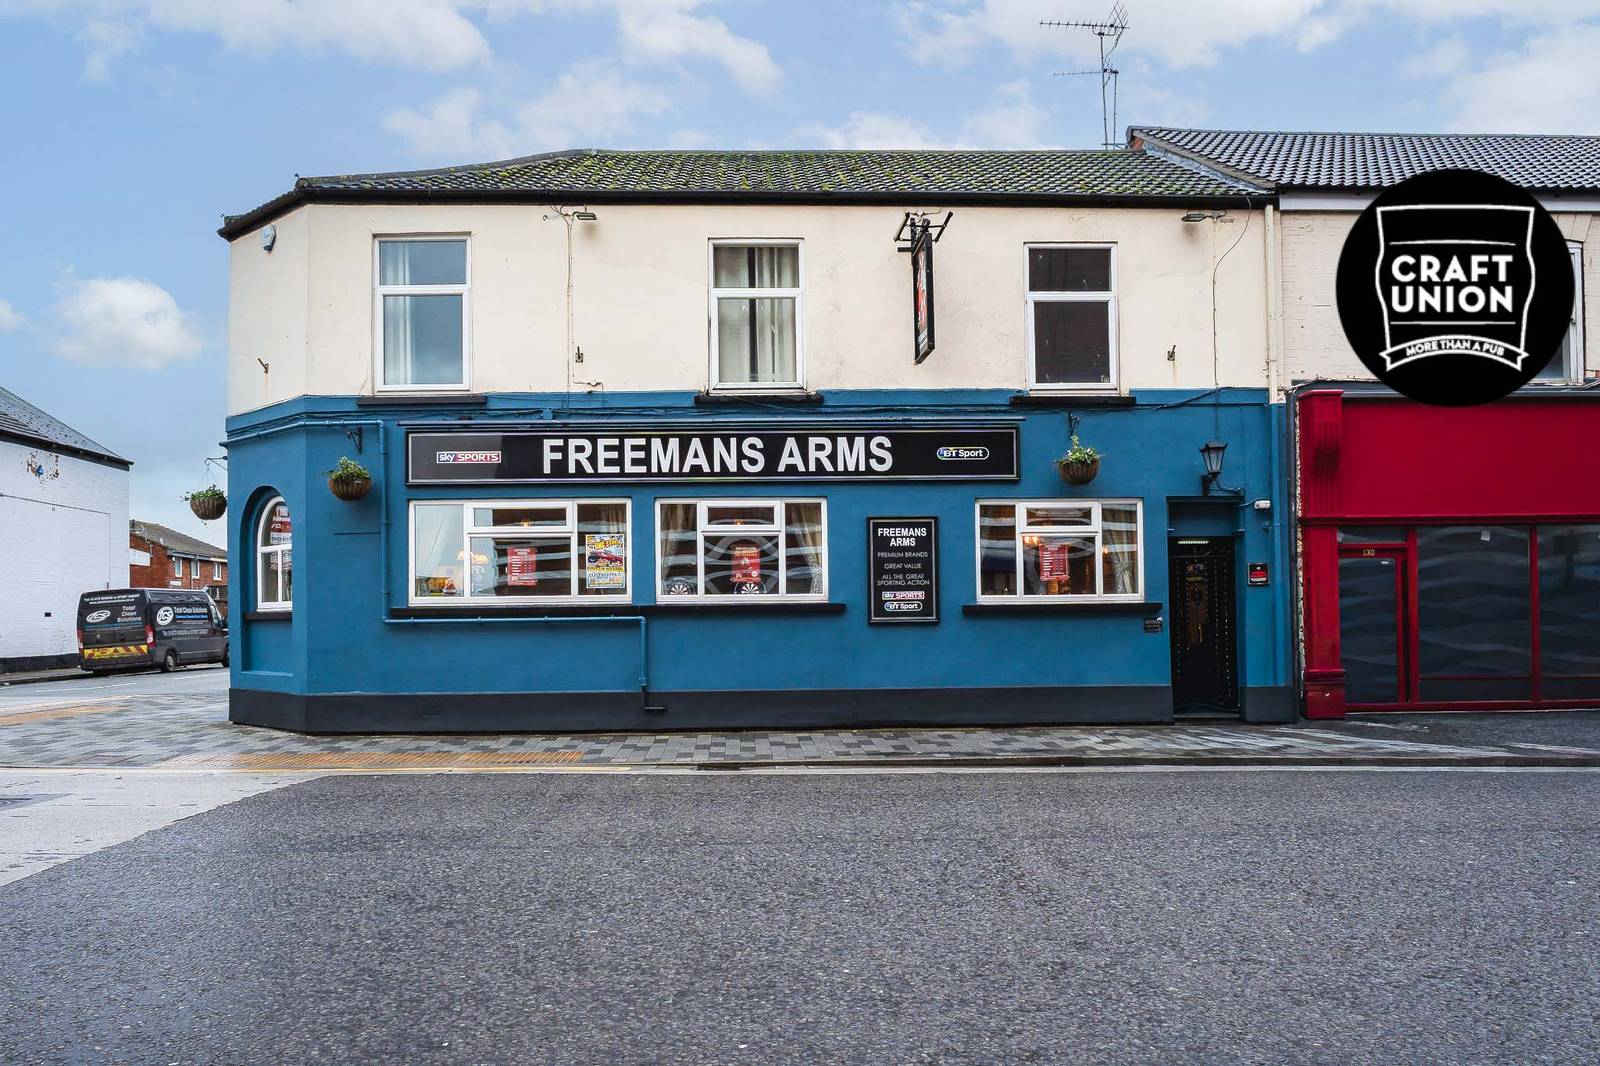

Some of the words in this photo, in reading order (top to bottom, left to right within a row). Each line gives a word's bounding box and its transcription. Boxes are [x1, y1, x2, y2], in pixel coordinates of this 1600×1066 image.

[439, 452, 455, 464] sky
[457, 453, 499, 462] SPORTS
[543, 437, 765, 474] FREEMANS
[777, 436, 893, 473] ARMS
[943, 448, 958, 458] BT
[958, 448, 984, 460] Sport
[877, 528, 927, 537] FREEMANS
[889, 537, 916, 547] ARMS
[899, 602, 918, 610] Sport
